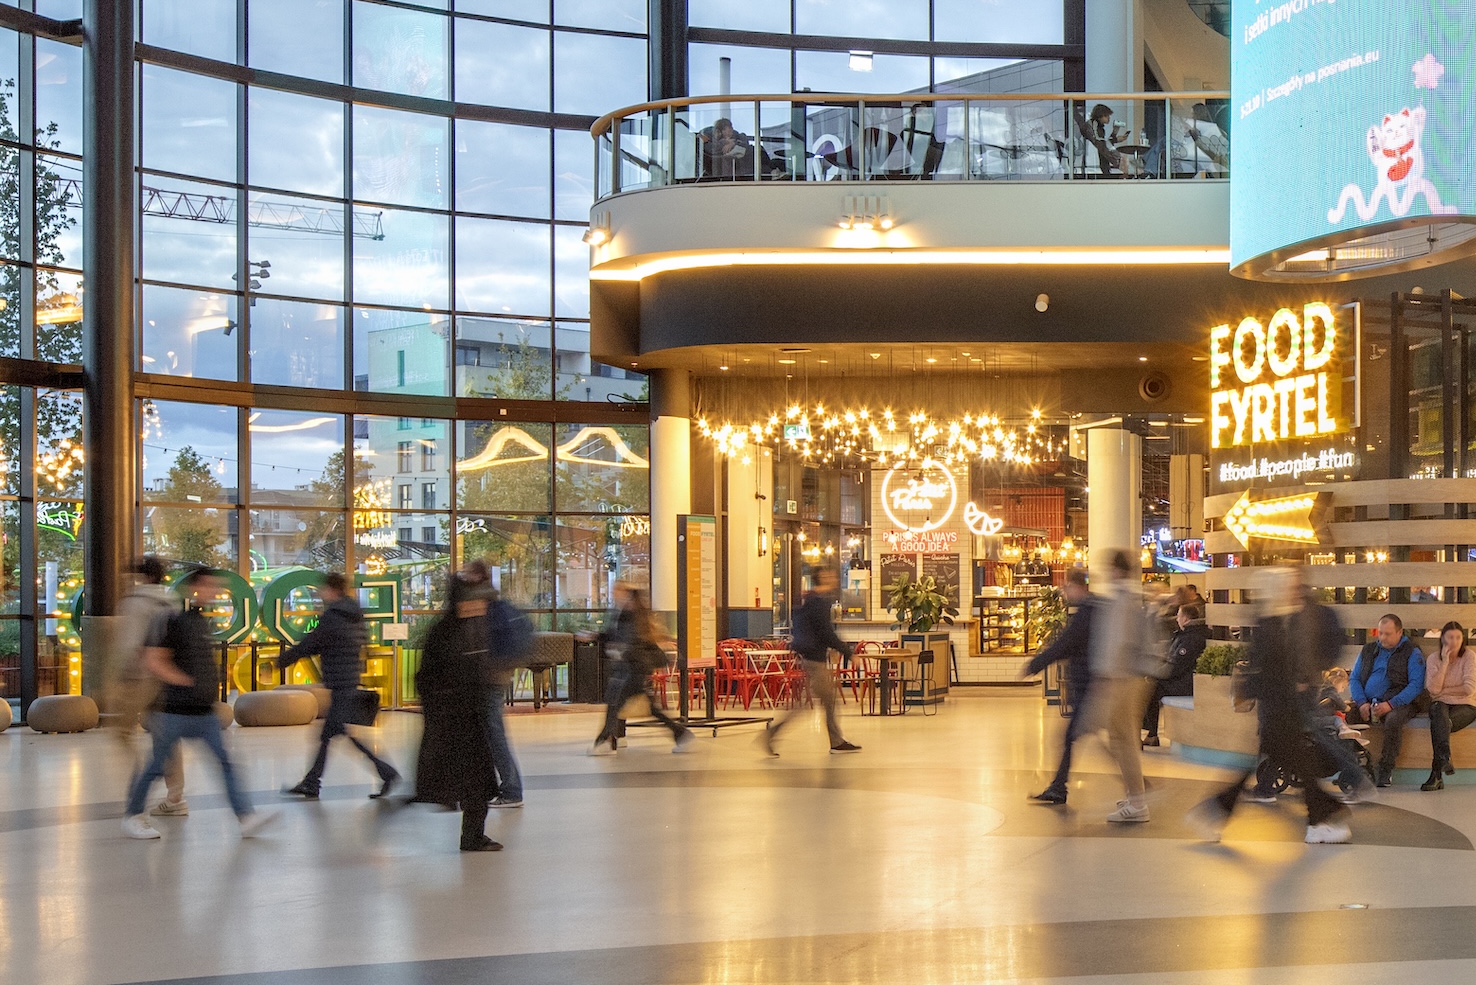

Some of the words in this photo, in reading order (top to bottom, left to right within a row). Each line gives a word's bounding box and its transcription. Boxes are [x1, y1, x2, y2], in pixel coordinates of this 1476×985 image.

[1248, 9, 1269, 43] setki
[1210, 300, 1337, 389] FOOD
[1210, 371, 1338, 449] FYRTEL
[1219, 456, 1258, 483] #food
[1259, 452, 1318, 483] #people
[900, 542, 925, 552] GOOD
[921, 532, 957, 542] ALWAYS
